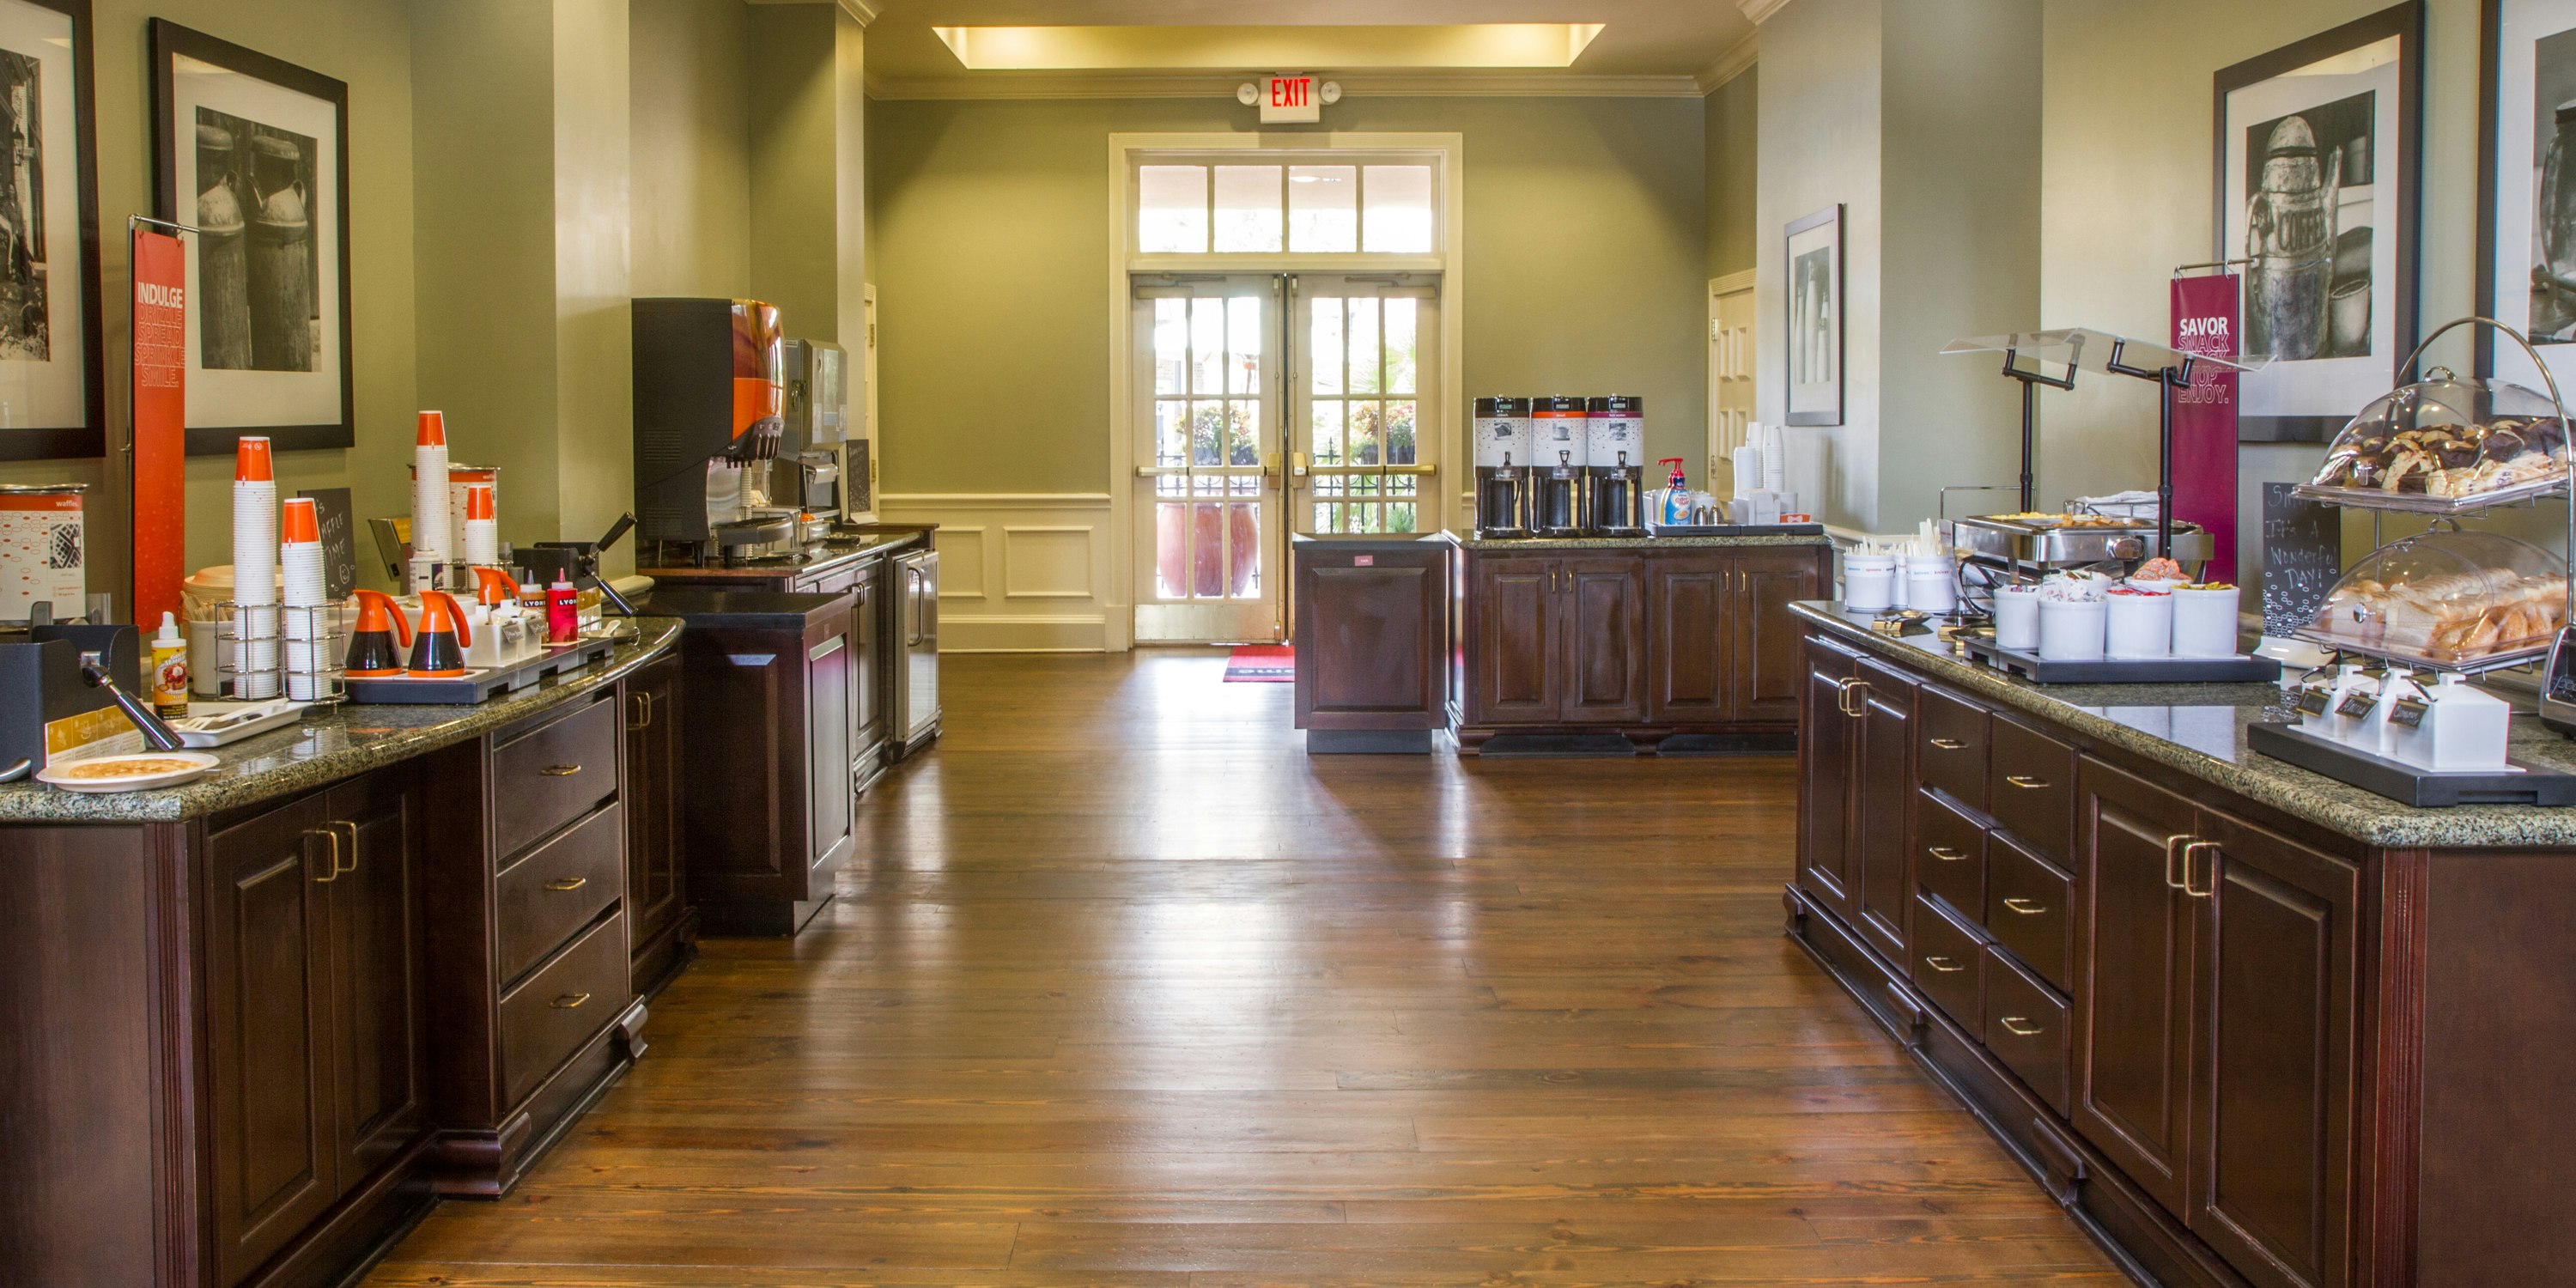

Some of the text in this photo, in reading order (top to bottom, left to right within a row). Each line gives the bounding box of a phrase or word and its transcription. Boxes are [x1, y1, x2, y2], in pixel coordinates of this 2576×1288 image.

[1272, 78, 1310, 107] EXIT
[137, 282, 183, 309] INDULGE
[138, 304, 182, 328] DRIZZLE
[2179, 316, 2228, 337] SAVOR
[137, 324, 182, 348] SPREAD
[2178, 332, 2230, 352] SNACK
[134, 343, 185, 368] SPRINKLE
[2178, 384, 2229, 404] ENJOY.
[321, 513, 344, 539] AFFLE
[2284, 568, 2322, 590] DAY!
